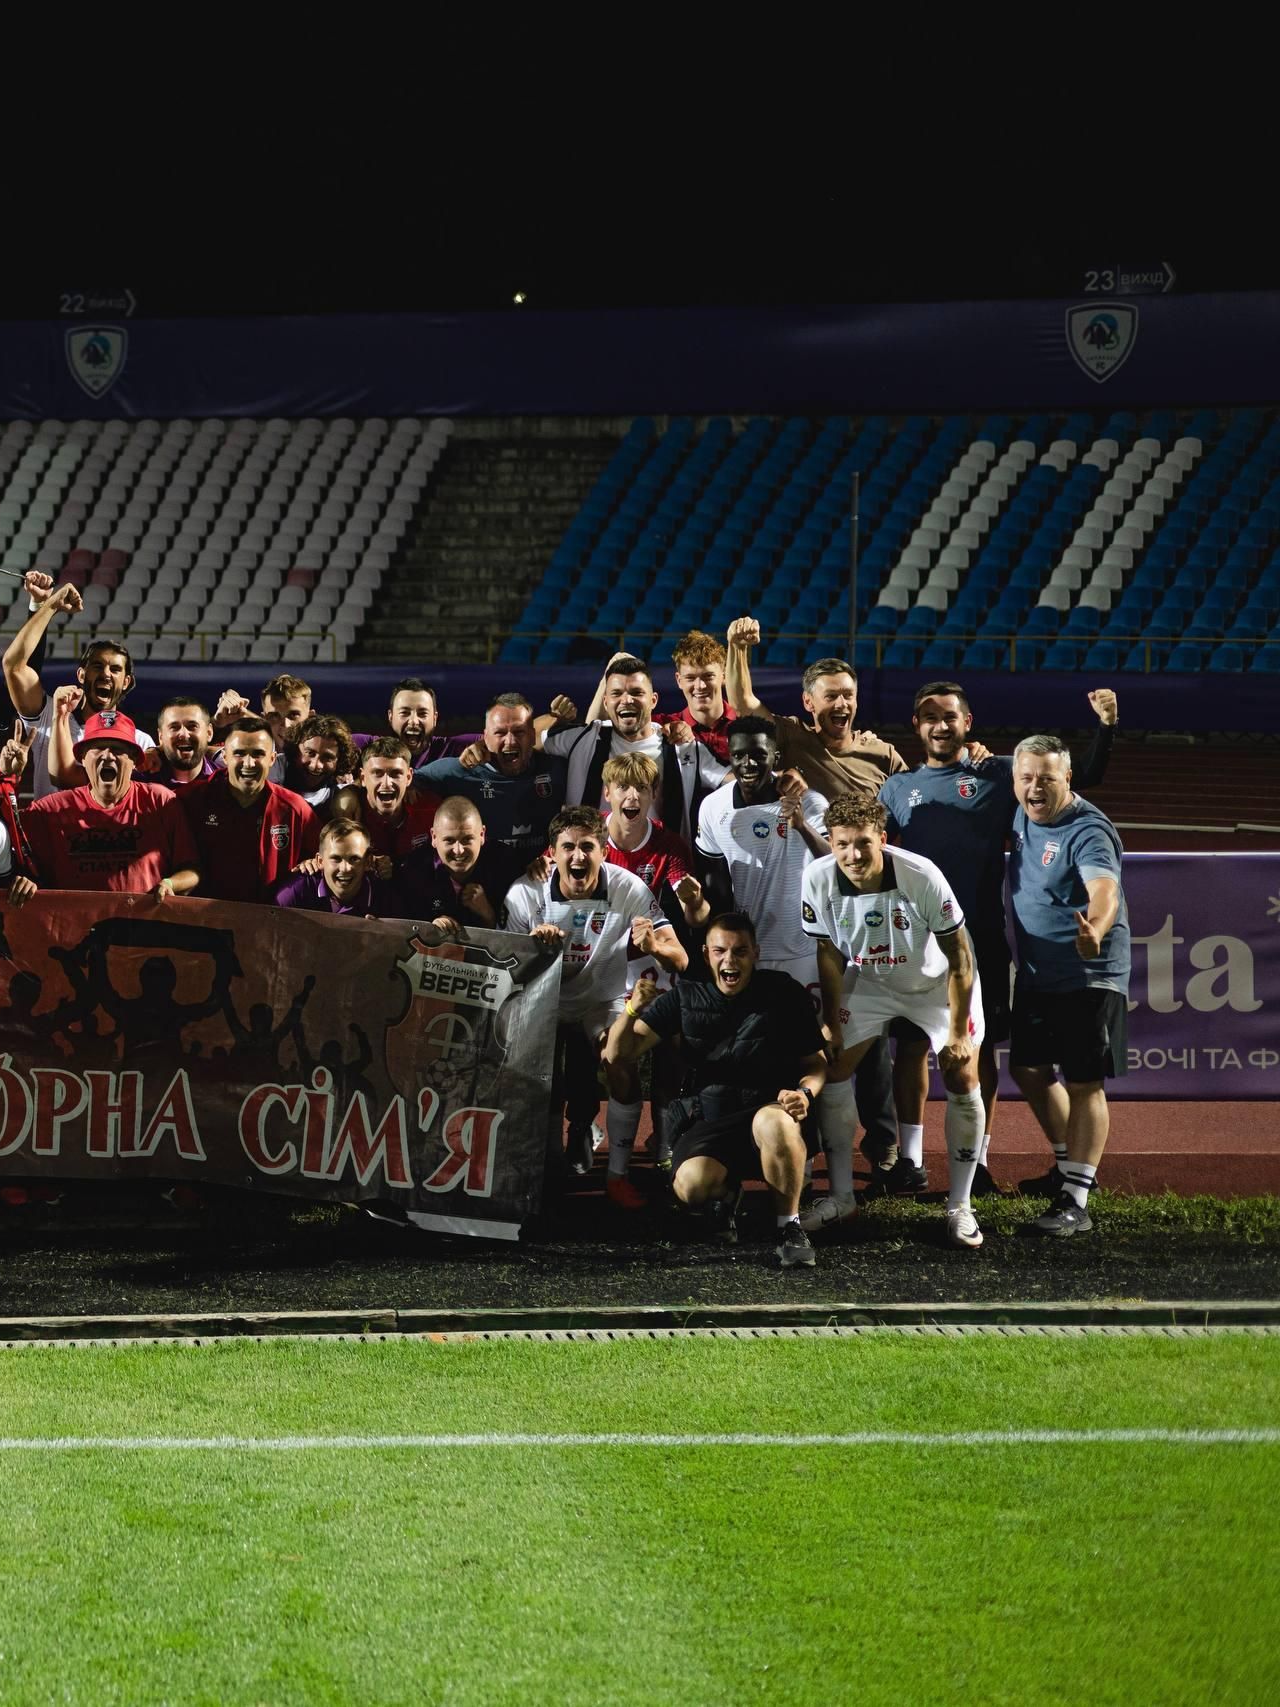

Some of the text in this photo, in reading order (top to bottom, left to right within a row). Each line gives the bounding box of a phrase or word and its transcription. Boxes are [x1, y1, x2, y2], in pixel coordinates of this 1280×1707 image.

[1084, 270, 1115, 291] 23
[60, 294, 85, 313] 22
[854, 955, 907, 966] BETKING
[423, 961, 499, 982] ФУТБОЛЬНИЙ КЛУБ
[420, 971, 497, 1003] ВЕРЕС
[1128, 1048, 1195, 1069] ВОЧІ
[1203, 1048, 1242, 1069] ТА
